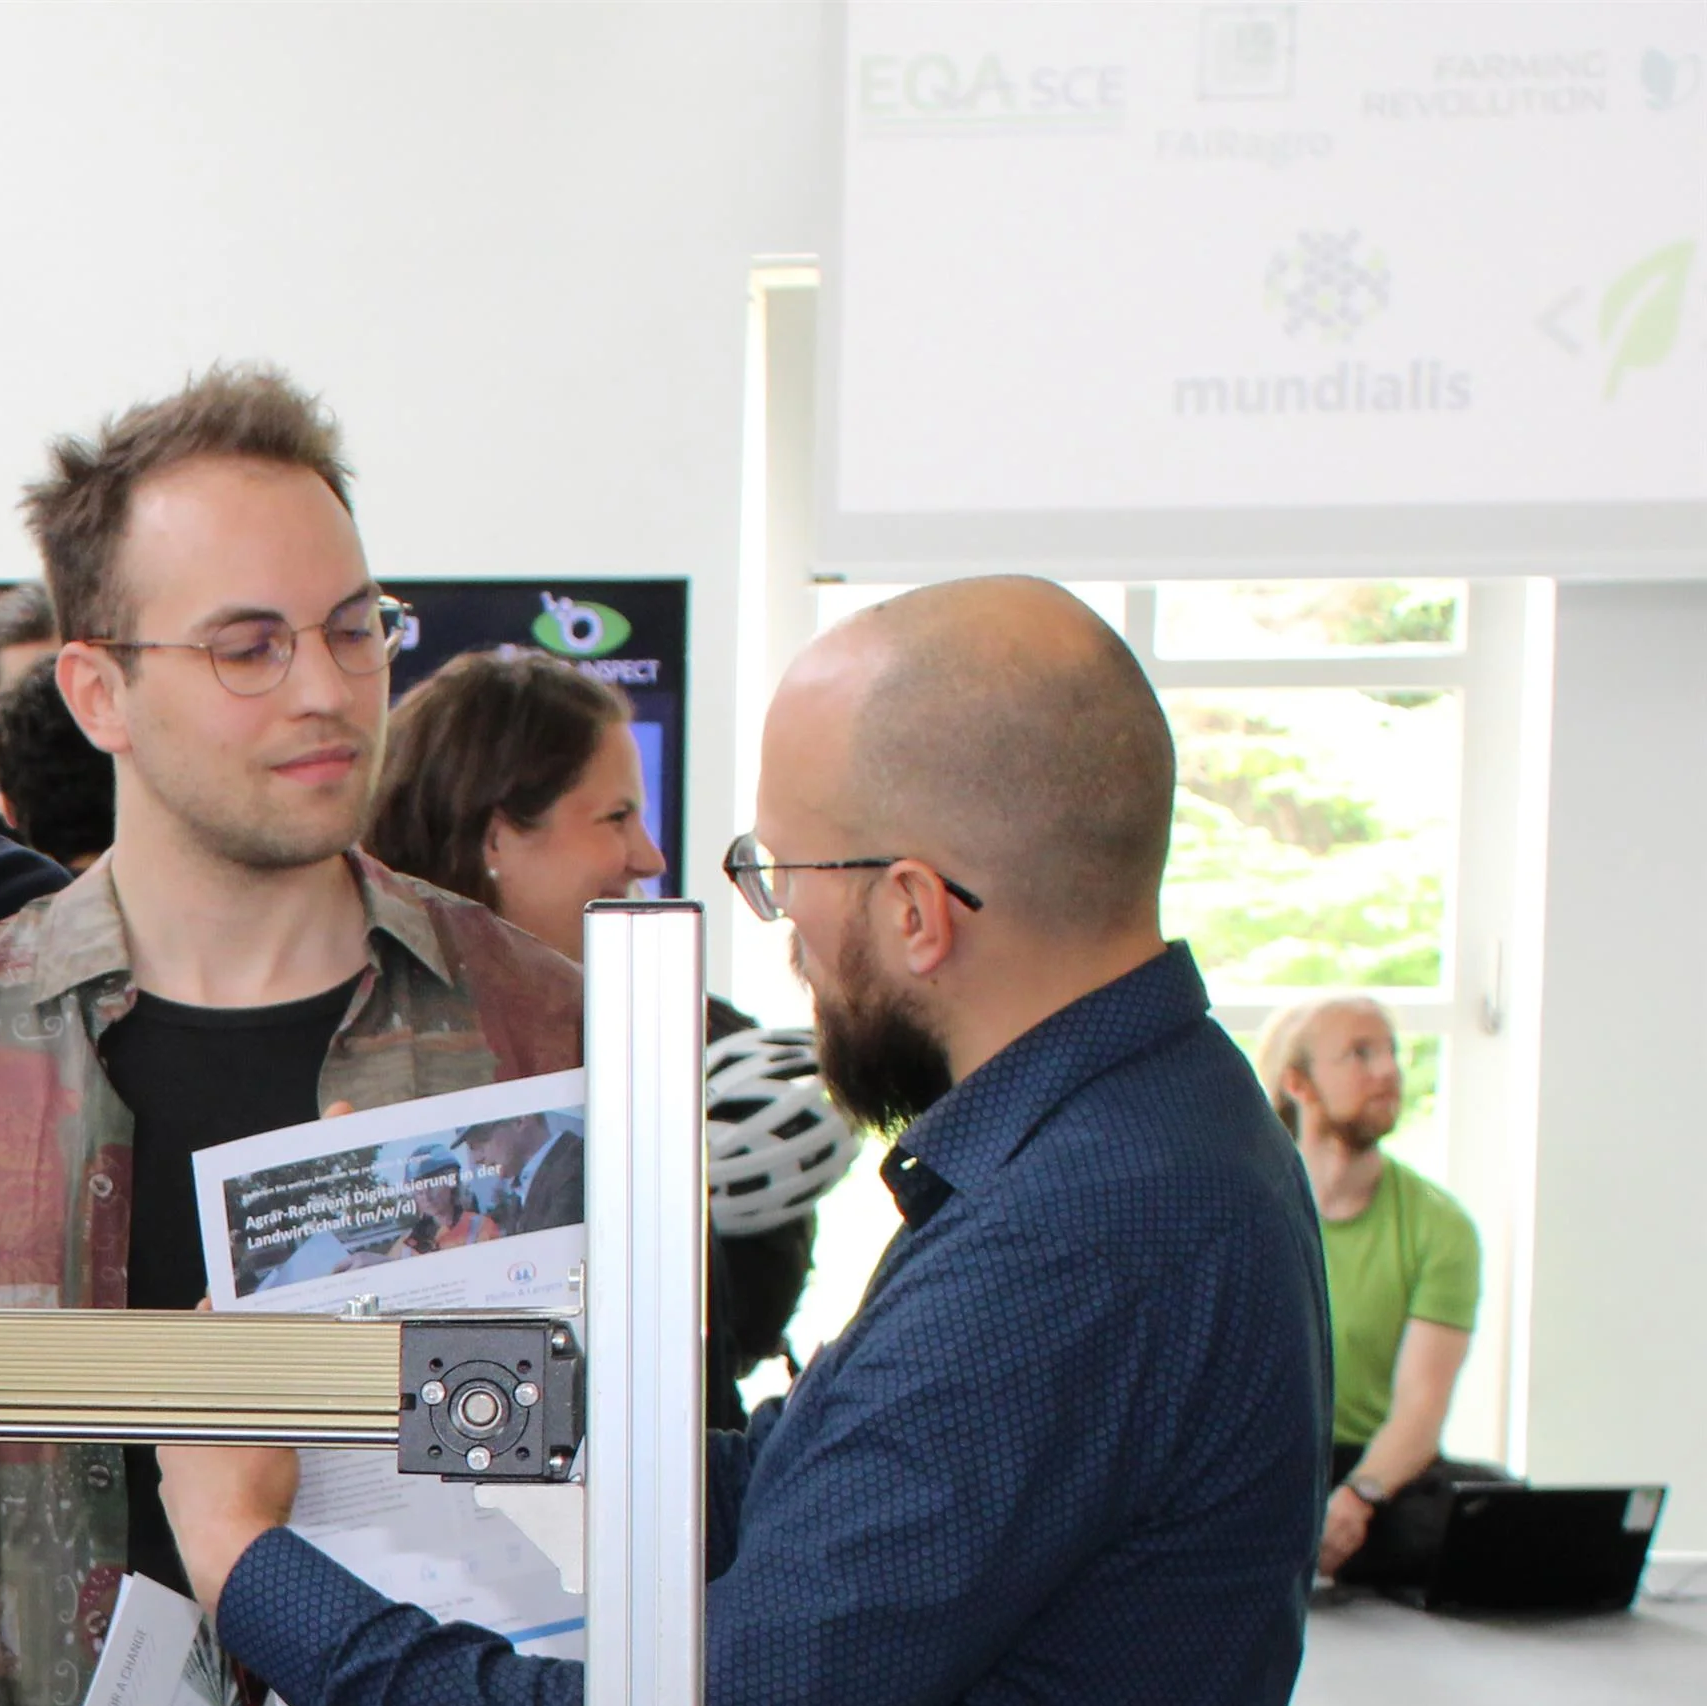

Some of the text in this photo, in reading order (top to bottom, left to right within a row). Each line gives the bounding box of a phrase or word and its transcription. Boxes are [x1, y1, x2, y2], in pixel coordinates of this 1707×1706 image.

[859, 53, 1127, 113] EQA SCE
[1433, 50, 1608, 85] FARMING
[1362, 82, 1608, 119] REVOLUTION
[1172, 358, 1474, 417] mundialis
[573, 659, 661, 684] INSPECT
[245, 1191, 351, 1231] Agrar-Referent
[353, 1170, 458, 1205] Digitalisierung
[460, 1168, 474, 1181] in
[476, 1163, 503, 1179] der
[247, 1199, 418, 1250] Landwirtschaft (m/w/d)
[120, 1625, 148, 1680] CHANGE
